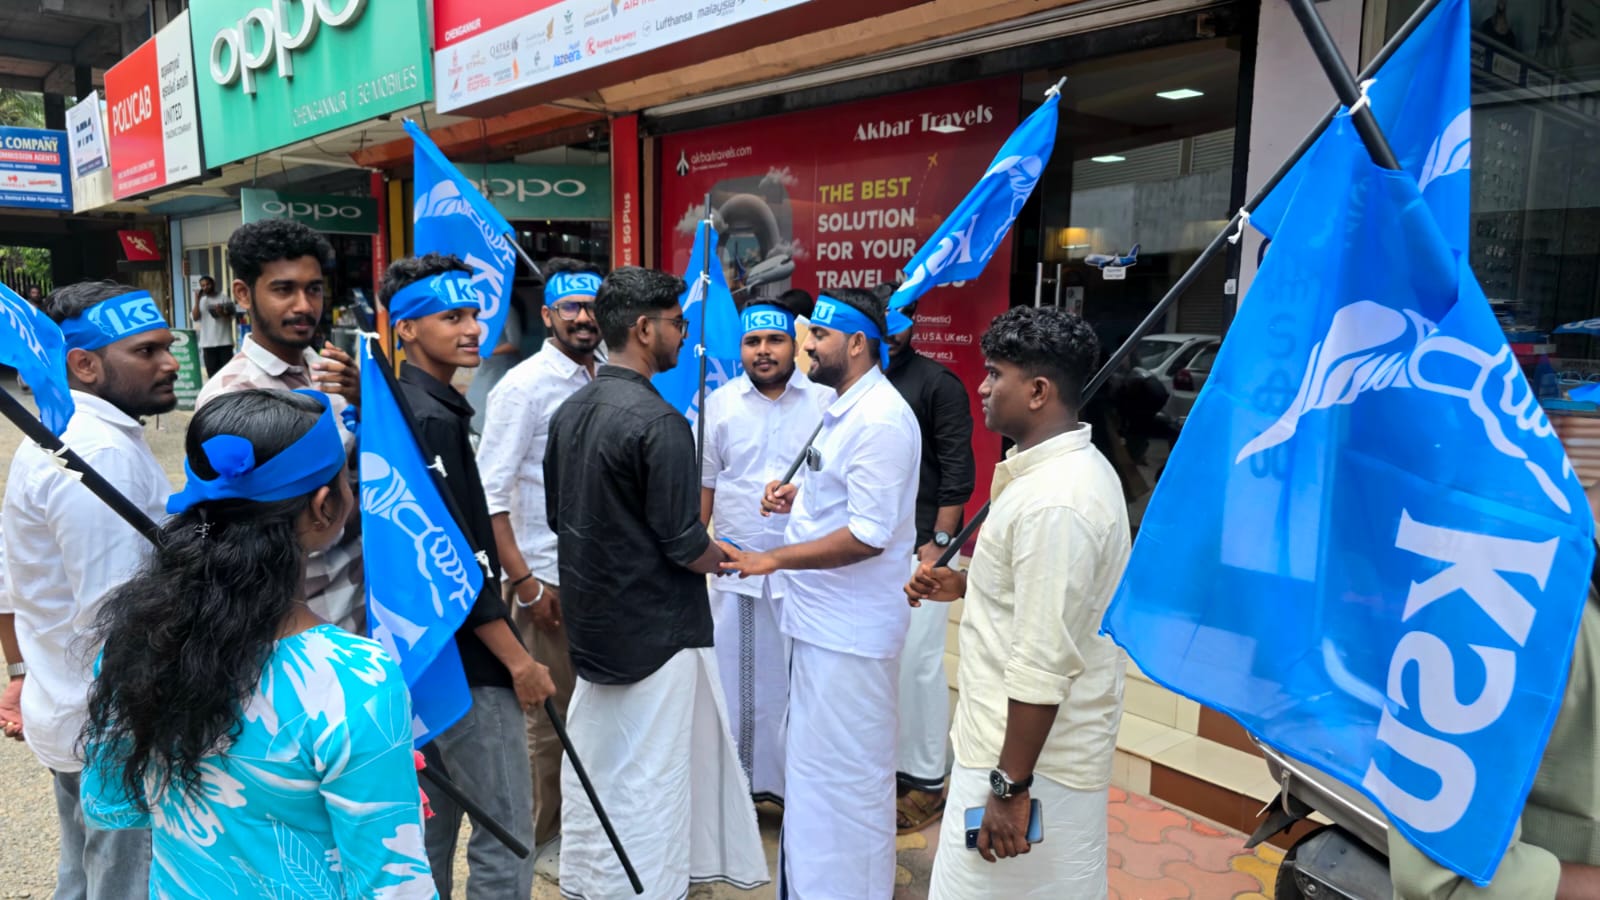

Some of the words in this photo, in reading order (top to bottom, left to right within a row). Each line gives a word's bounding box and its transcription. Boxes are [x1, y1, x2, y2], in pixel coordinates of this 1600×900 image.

[444, 18, 482, 42] CHENGANNUR
[655, 11, 693, 32] Lufthansa
[553, 50, 582, 67] Jazeera
[293, 91, 347, 127] CHENGANNUR
[370, 65, 418, 101] MOBILES
[112, 84, 153, 137] POLYCAB
[853, 119, 914, 141] Akbar
[919, 104, 993, 132] Travels
[5, 137, 58, 152] COMPANY
[691, 146, 752, 164] akbartravels.com
[475, 179, 586, 202] ppo
[819, 183, 854, 204] THE
[861, 176, 912, 200] BEST
[262, 199, 363, 221] oppo
[817, 207, 915, 233] SOLUTION
[816, 242, 854, 261] FOR
[861, 238, 917, 259] YOUR
[816, 269, 882, 289] TRAVEL
[748, 312, 785, 329] KSU
